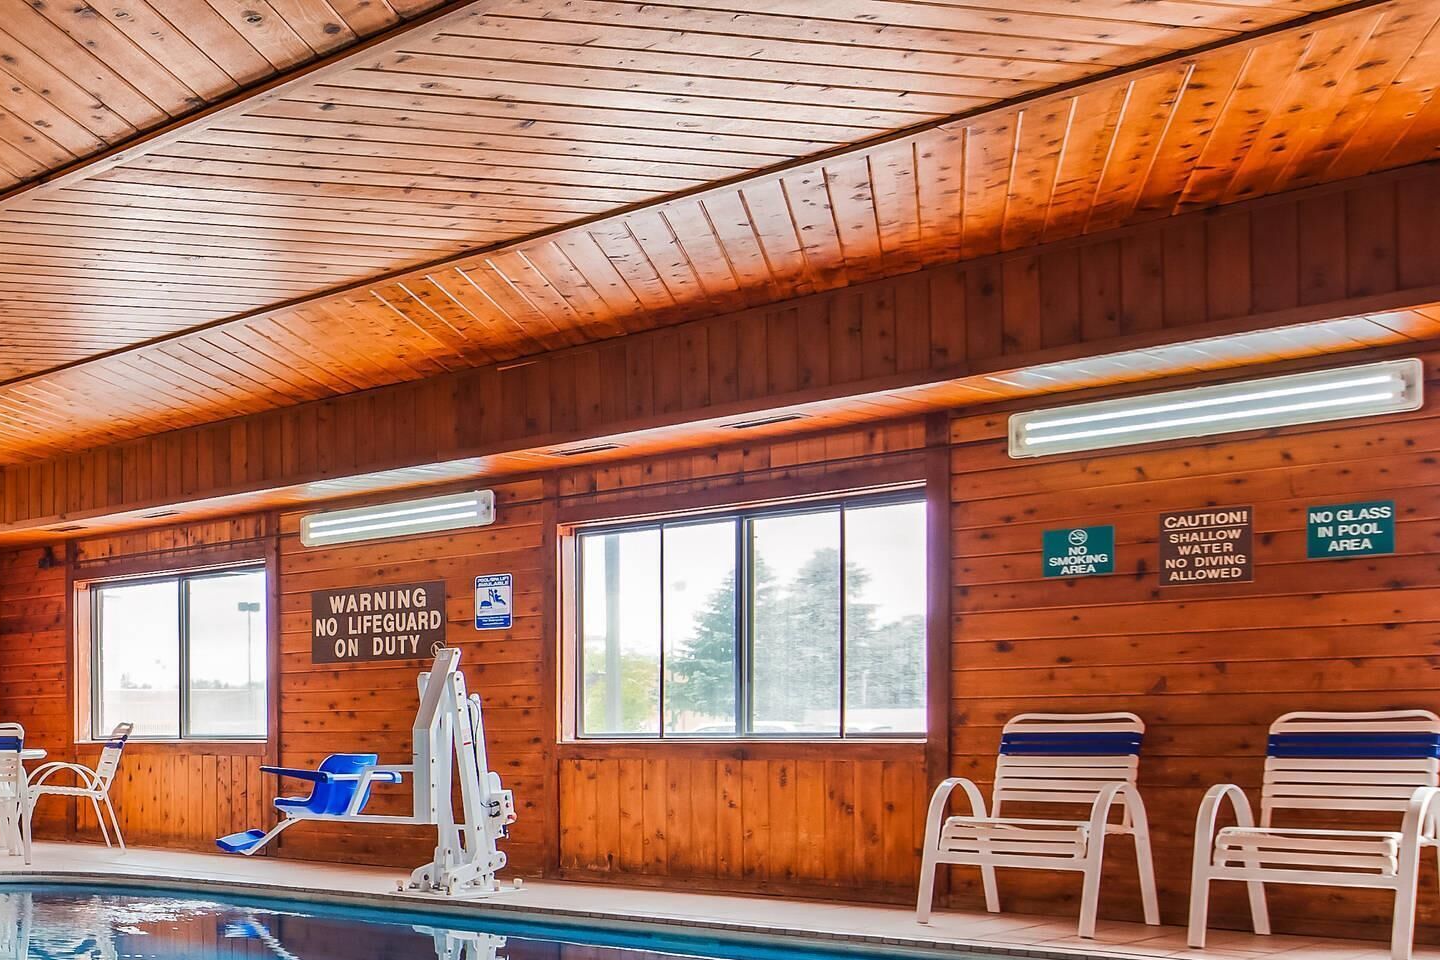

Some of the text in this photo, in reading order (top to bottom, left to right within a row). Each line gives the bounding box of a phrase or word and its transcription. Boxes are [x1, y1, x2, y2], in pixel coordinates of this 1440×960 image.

[1164, 510, 1249, 529] CAUTION!
[1309, 506, 1392, 523] NO GLASS
[1169, 529, 1242, 544] SHALLOW
[1317, 522, 1383, 538] IN POOL
[1068, 546, 1088, 556] NO
[1177, 543, 1234, 556] WATER
[1328, 538, 1373, 552] AREA
[1048, 554, 1108, 567] SMOKING
[1165, 554, 1246, 569] NO DIVING
[1060, 563, 1096, 575] AREA
[1169, 567, 1243, 582] ALLOWED
[329, 587, 427, 614] WARNING
[315, 610, 441, 637] NO LIFEGUARD
[335, 635, 420, 658] ON DUTY
